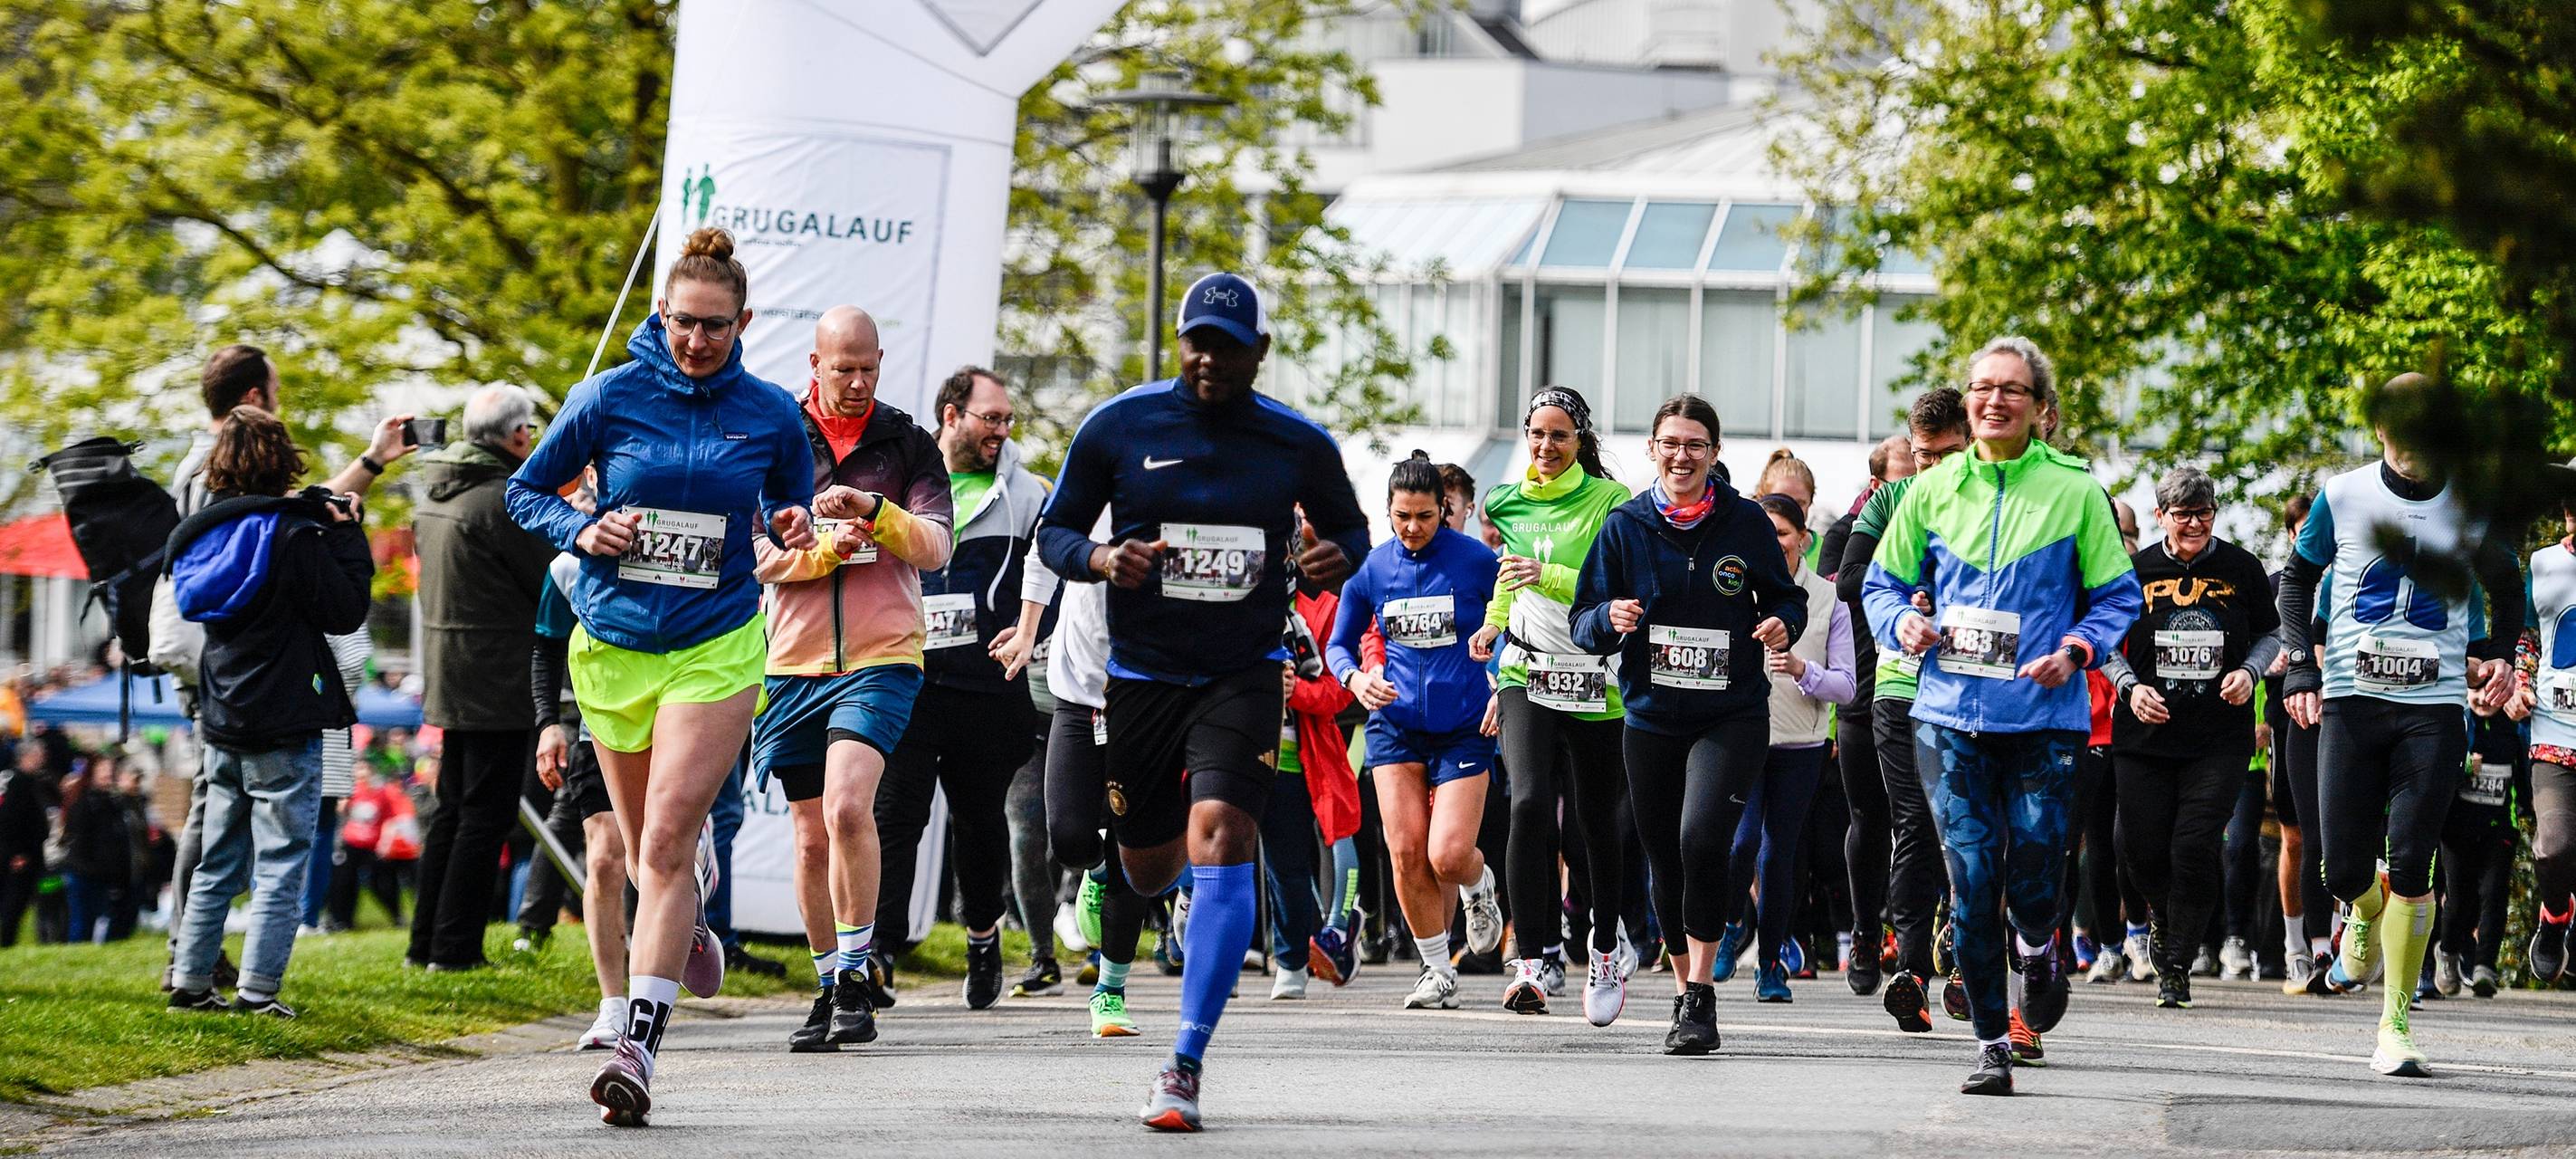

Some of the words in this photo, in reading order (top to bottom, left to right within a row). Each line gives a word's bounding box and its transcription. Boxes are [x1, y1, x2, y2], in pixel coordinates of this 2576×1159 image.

[712, 206, 913, 244] GRUGALAUF
[656, 518, 698, 530] GRUGALAUF
[1512, 522, 1576, 532] GRUGALAUF
[640, 532, 702, 560] 1247
[1181, 550, 1245, 576] 1249
[1718, 570, 1736, 579] onco
[1668, 647, 1707, 667] 608
[2169, 647, 2211, 663] 1076
[2371, 656, 2422, 676] 1004
[1547, 672, 1585, 692] 932
